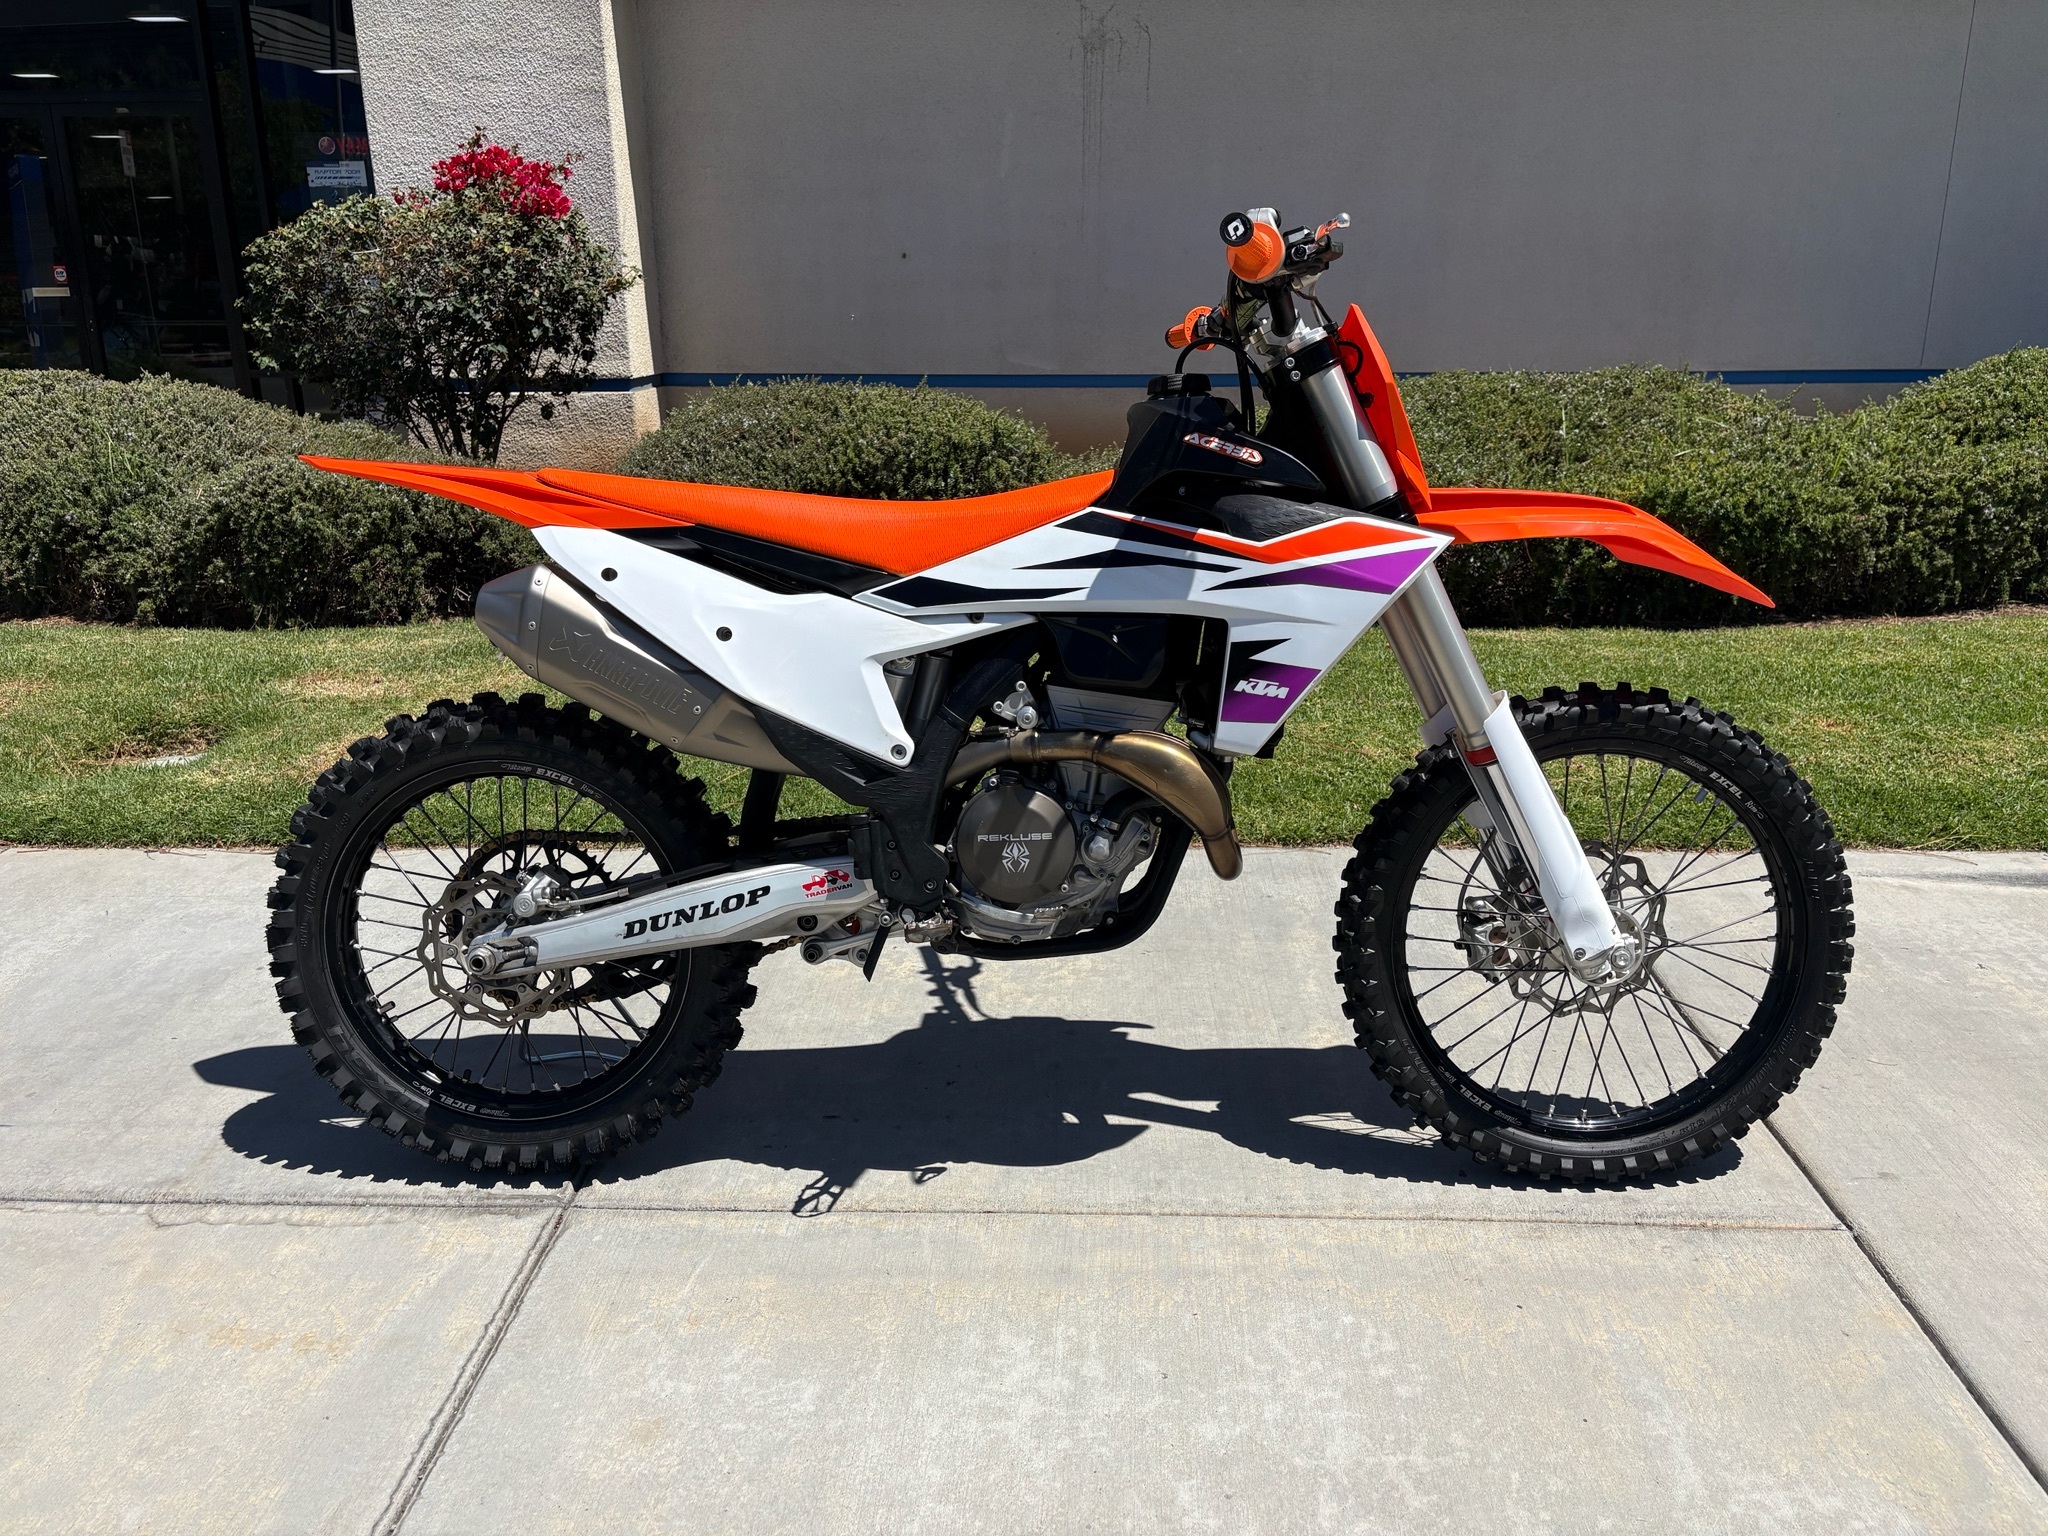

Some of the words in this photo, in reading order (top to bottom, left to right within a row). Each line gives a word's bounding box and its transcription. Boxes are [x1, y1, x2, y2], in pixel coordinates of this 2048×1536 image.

[1233, 678, 1290, 699] KTM
[535, 767, 575, 786] EXCEL
[1709, 771, 1743, 799] EXCEL
[977, 832, 1053, 842] REKLUSE
[805, 882, 853, 899] TRADERVAN
[622, 885, 771, 939] DUNLOP
[440, 1093, 477, 1112] EXCEL
[1460, 1084, 1493, 1112] EXCEL
